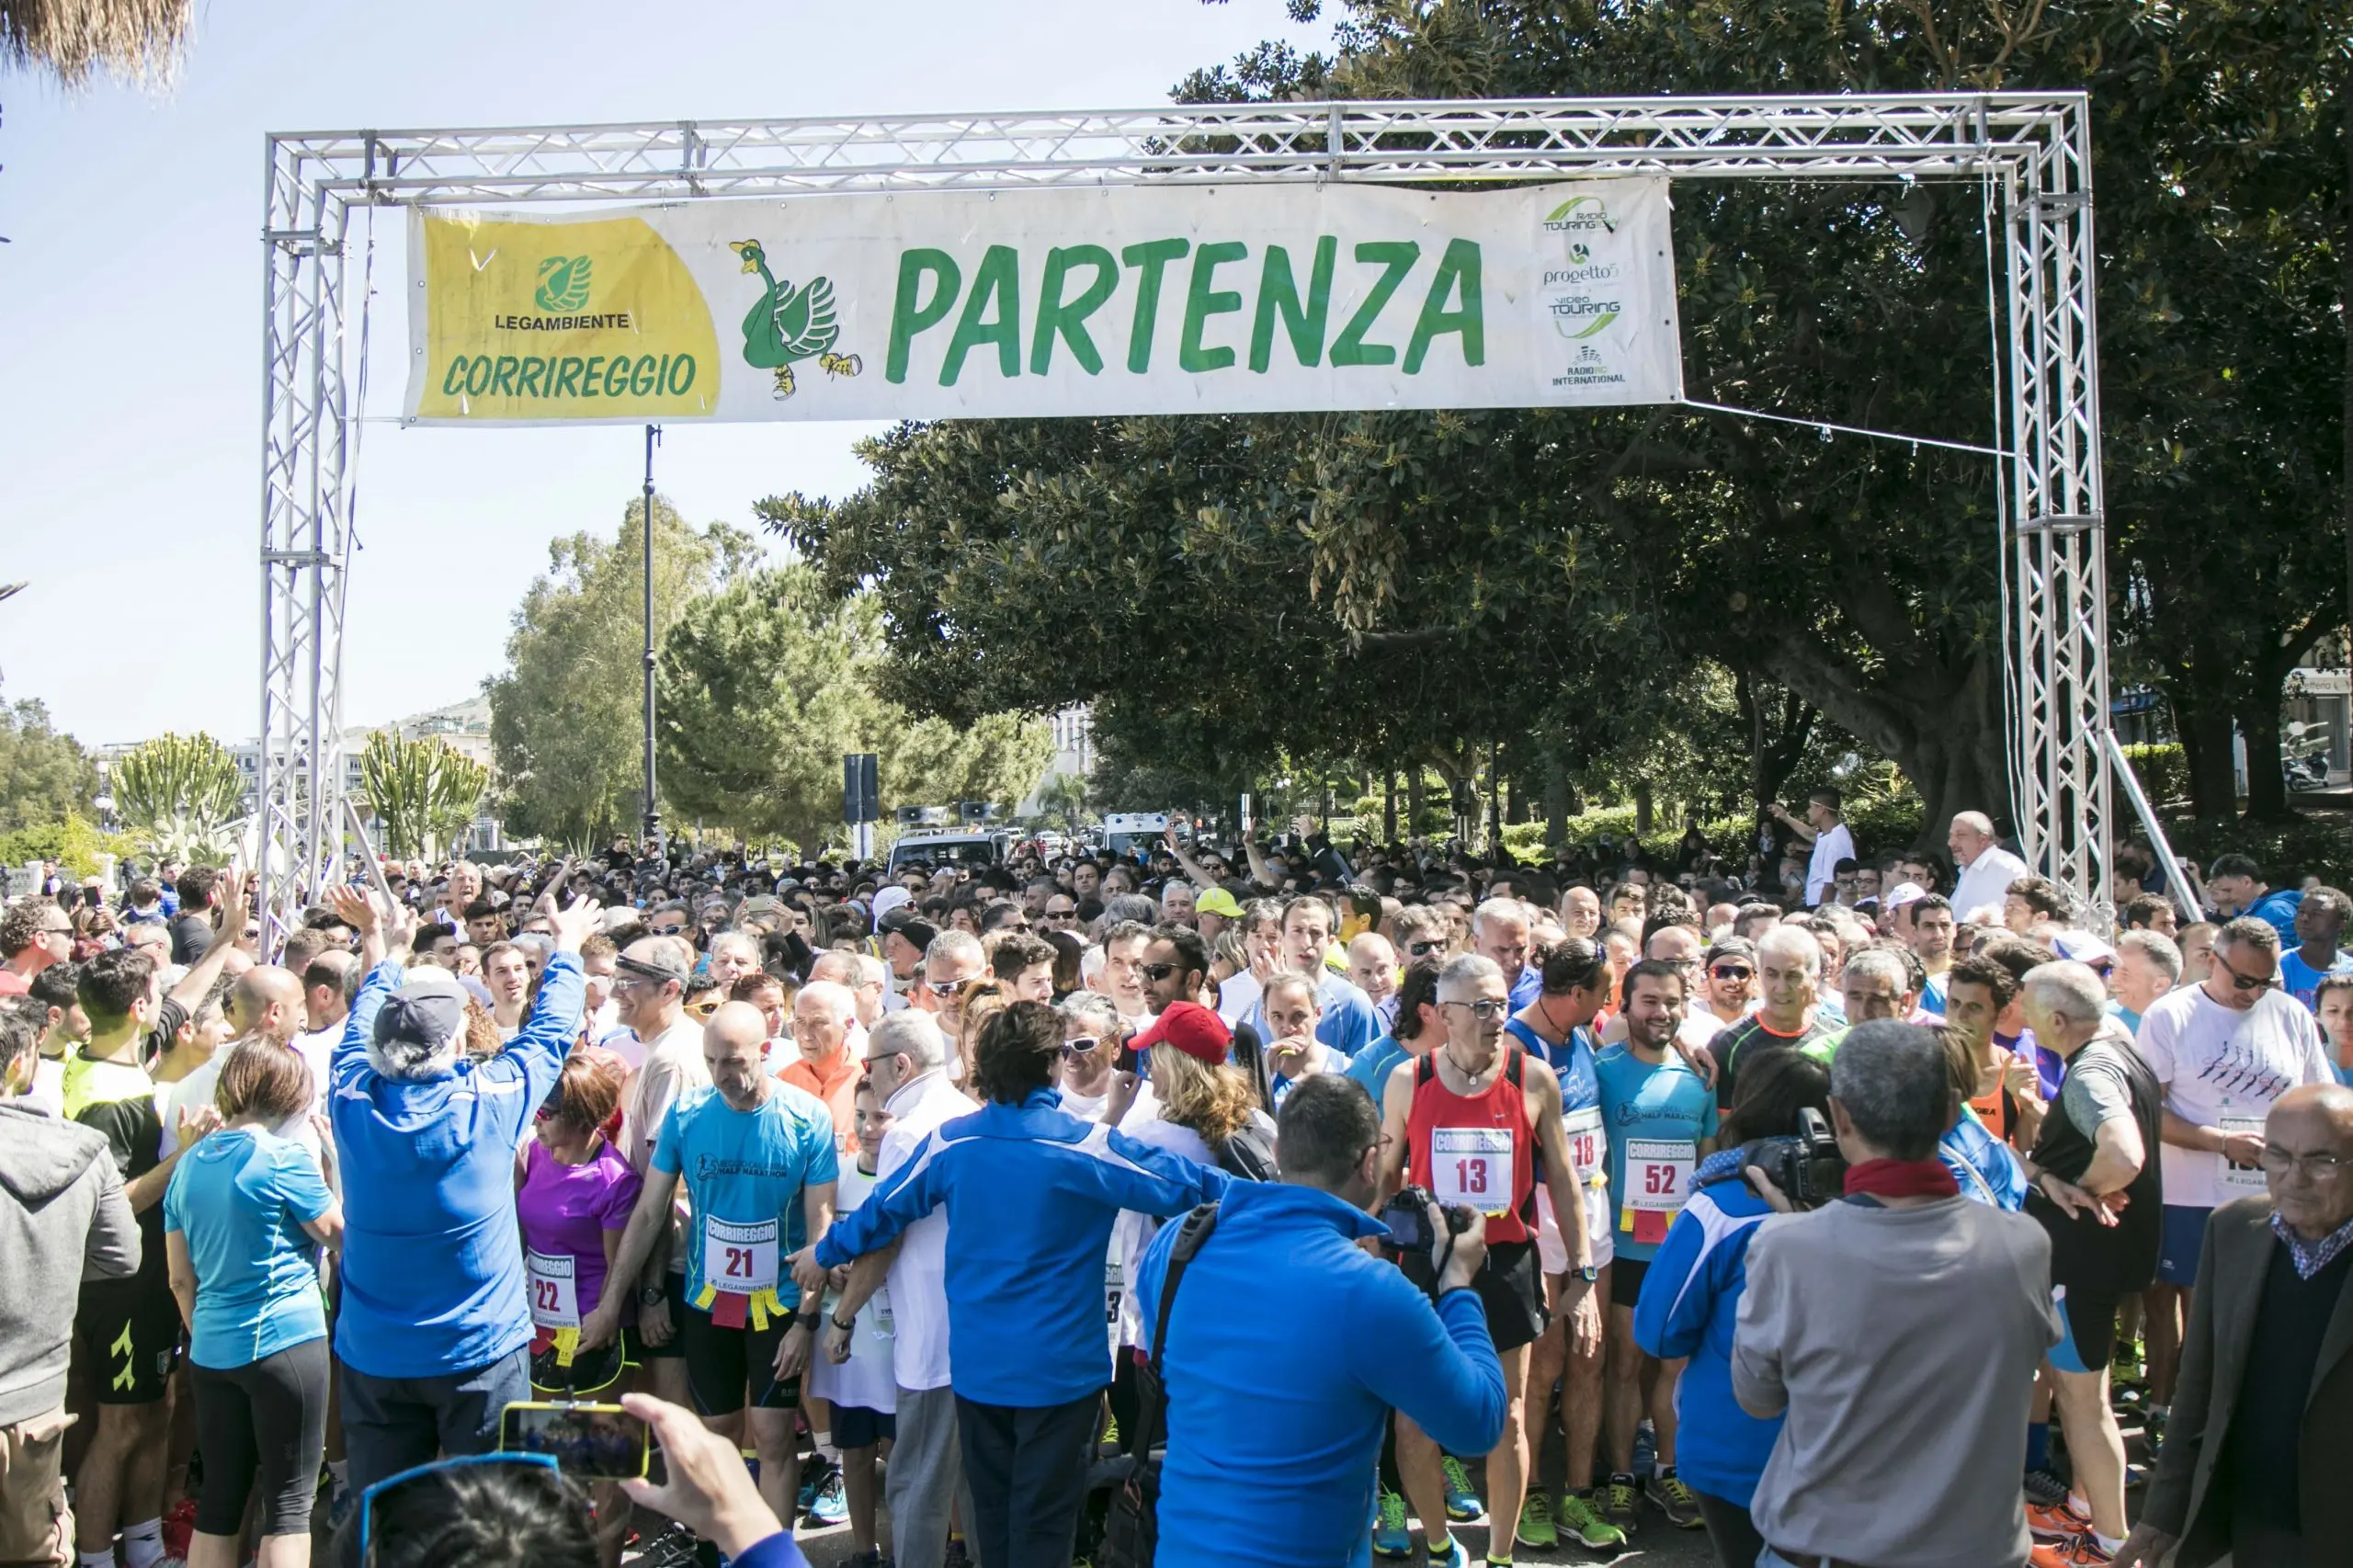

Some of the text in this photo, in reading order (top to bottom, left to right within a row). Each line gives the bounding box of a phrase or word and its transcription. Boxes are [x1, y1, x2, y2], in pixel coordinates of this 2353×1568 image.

[1543, 221, 1596, 231] TOURING
[885, 235, 1484, 386] PARTENZA
[1548, 301, 1620, 314] TOURING
[494, 313, 630, 332] LEGAMBIENTE
[442, 353, 696, 398] CORRIREGGIO
[1552, 374, 1625, 386] INTERNATIONAL
[1436, 1133, 1510, 1152] CORRIREGGIO
[1574, 1135, 1594, 1167] 18
[1629, 1142, 1693, 1159] CORRIREGGIO
[1456, 1158, 1487, 1193] 13
[1645, 1165, 1676, 1194] 52
[709, 1220, 775, 1243] CORRIREGGIO
[725, 1247, 753, 1278] 21
[536, 1278, 561, 1312] 22
[719, 1281, 773, 1291] LEGAMBIENTE
[536, 1315, 575, 1328] LEGAMBIENTE
